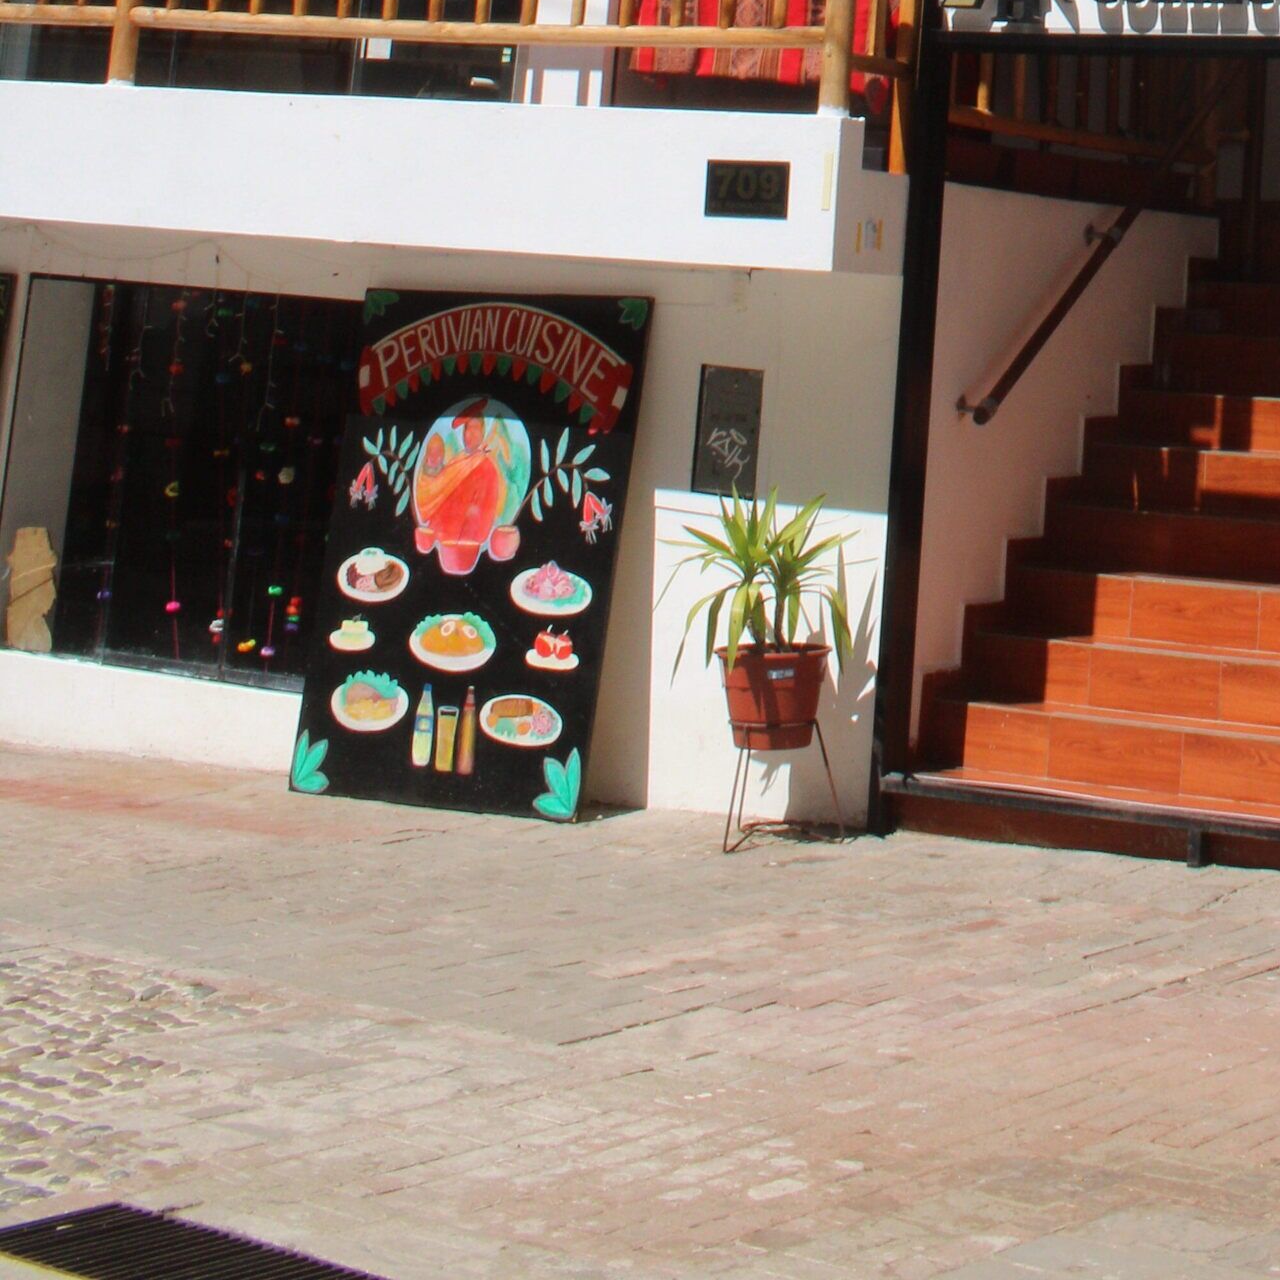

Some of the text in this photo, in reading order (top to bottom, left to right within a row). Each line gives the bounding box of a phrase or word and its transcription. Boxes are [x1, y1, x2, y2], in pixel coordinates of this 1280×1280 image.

[718, 167, 778, 200] 709
[376, 309, 619, 402] PERUVIAN CUISINE
